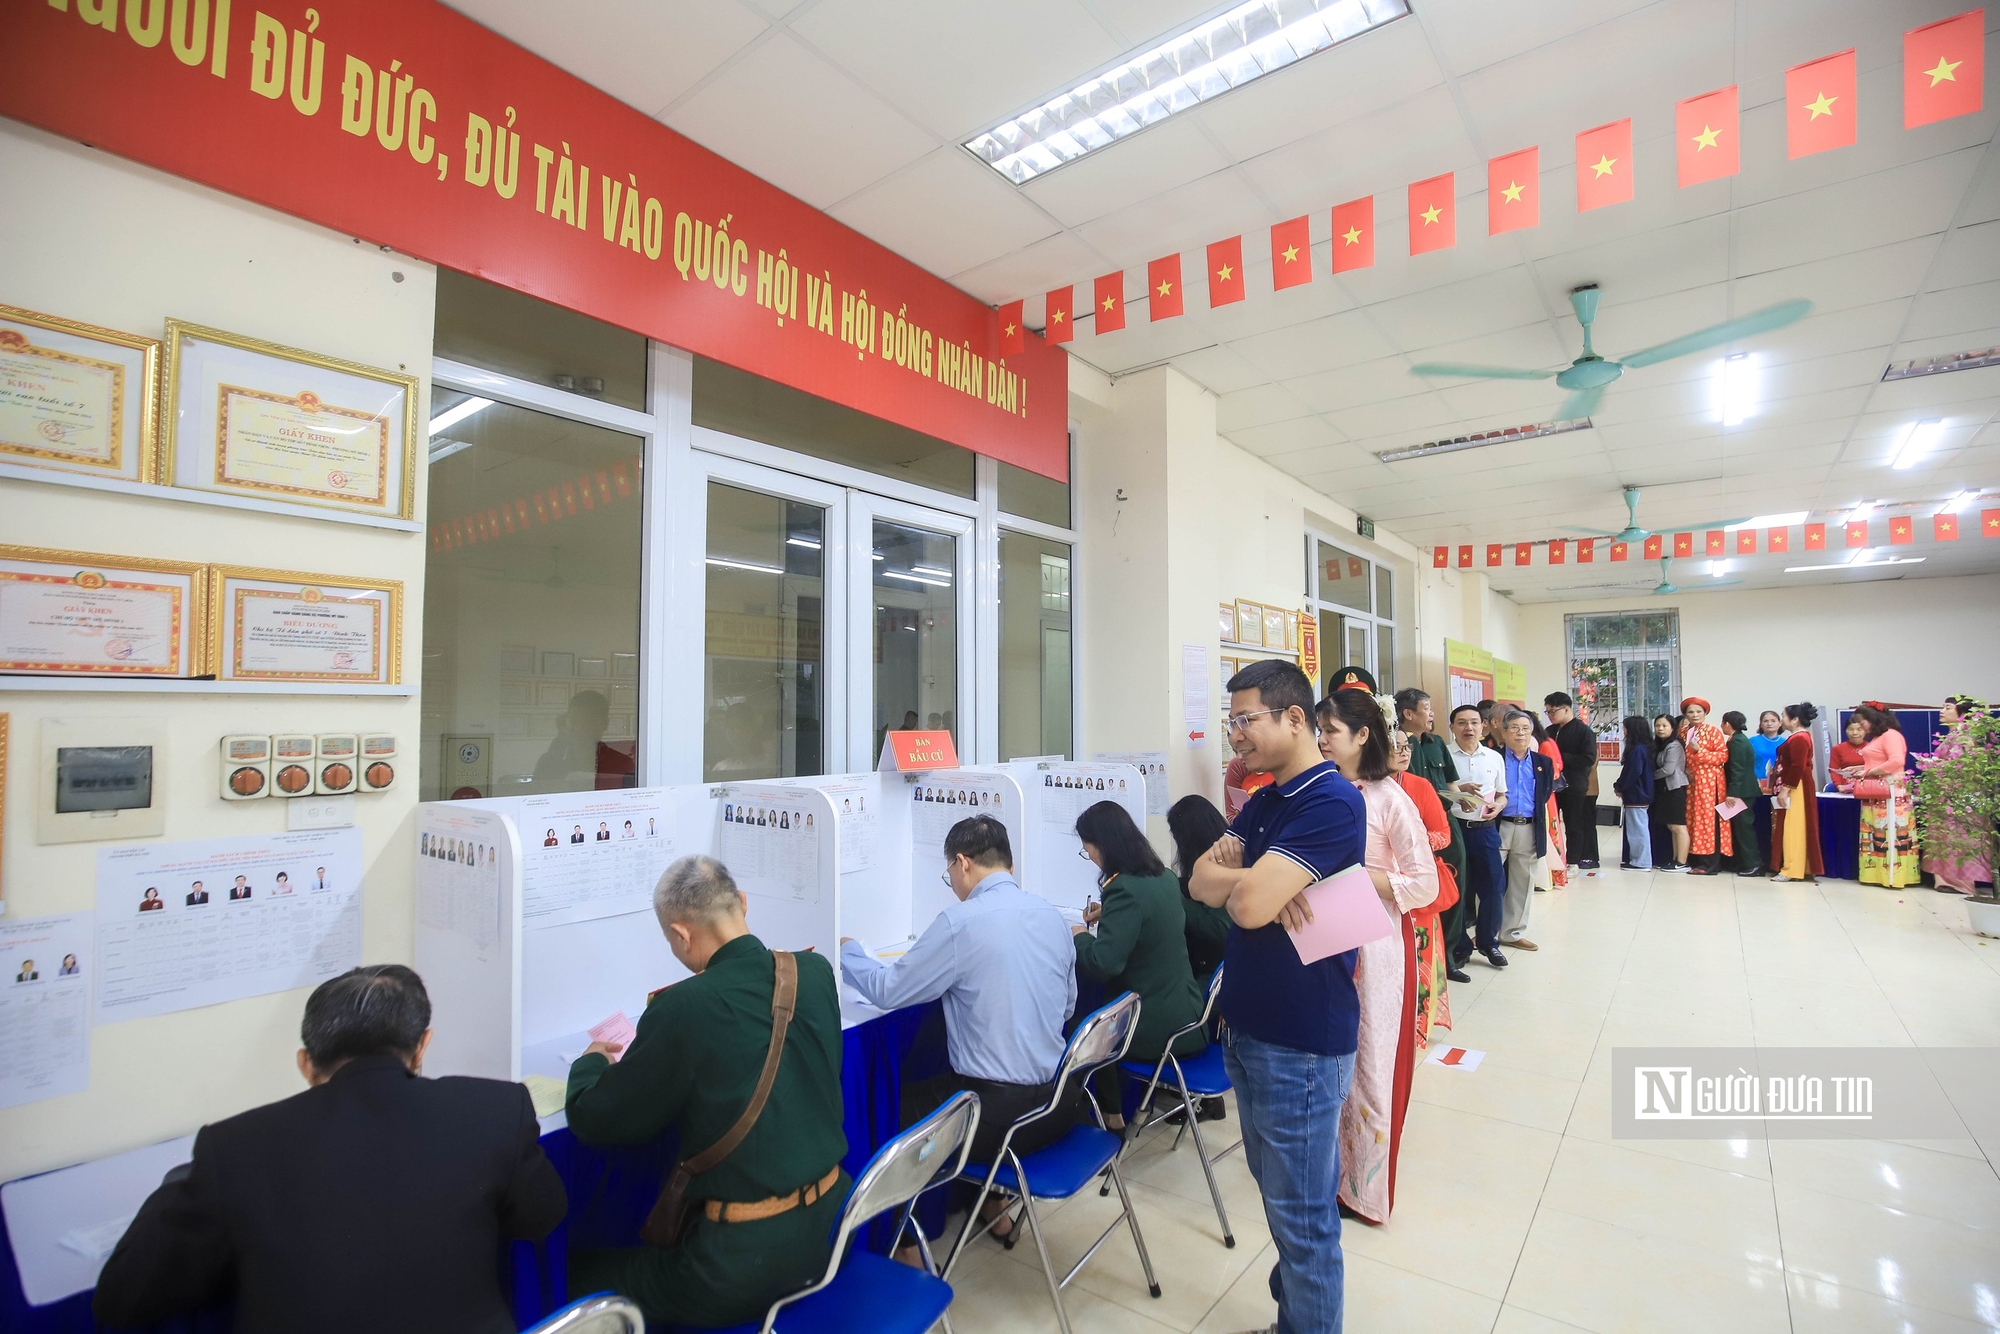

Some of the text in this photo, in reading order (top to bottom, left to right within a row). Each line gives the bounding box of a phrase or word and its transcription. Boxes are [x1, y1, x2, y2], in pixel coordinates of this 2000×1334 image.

[251, 8, 325, 116] ĐỦ
[341, 60, 448, 181] ĐỨC,
[465, 106, 520, 199] ĐỦ
[534, 142, 589, 230] TÀI
[602, 174, 663, 260] VÀO
[674, 212, 748, 297] QUỐC
[757, 249, 798, 327] HỘI
[806, 271, 833, 336] VÀ
[841, 289, 876, 361] HỘI
[882, 303, 932, 378] ĐỒNG
[938, 341, 982, 399] NHÂN
[987, 358, 1017, 414] DÂN
[1021, 379, 1027, 418] !
[279, 427, 336, 444] GIẤY KHEN
[1362, 520, 1373, 538] EXIT
[914, 737, 931, 747] BÀN
[909, 748, 944, 762] BẦU CỬ
